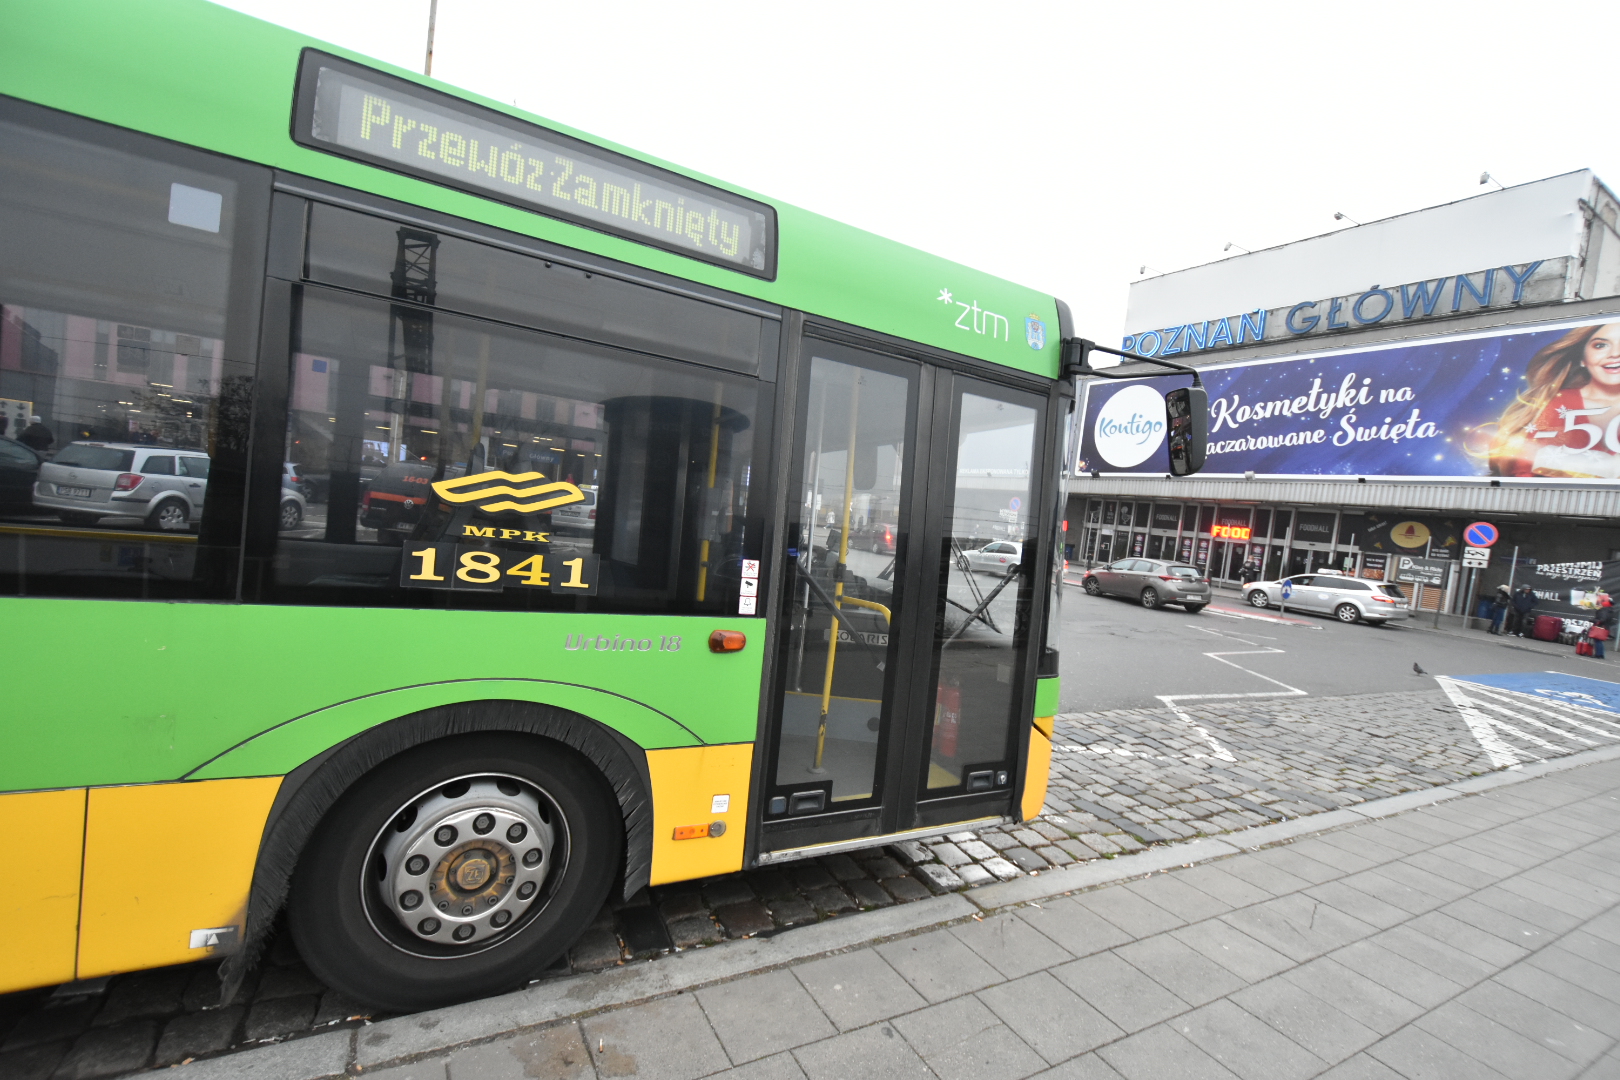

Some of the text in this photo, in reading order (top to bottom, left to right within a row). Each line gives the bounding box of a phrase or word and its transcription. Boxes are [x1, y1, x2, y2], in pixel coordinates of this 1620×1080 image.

[361, 94, 740, 257] Przewóz Zamknięty
[1121, 260, 1545, 362] POZNAŃ GŁÓWNY
[1211, 372, 1415, 433] Kosmetyki na
[1099, 412, 1163, 446] Kontigo
[1205, 408, 1440, 458] aczarowane Święta
[462, 525, 550, 543] MPK
[1211, 525, 1252, 540] FOOD
[1299, 523, 1330, 533] FOODHALL
[409, 547, 589, 589] 1841
[565, 633, 683, 652] Urbino 18
